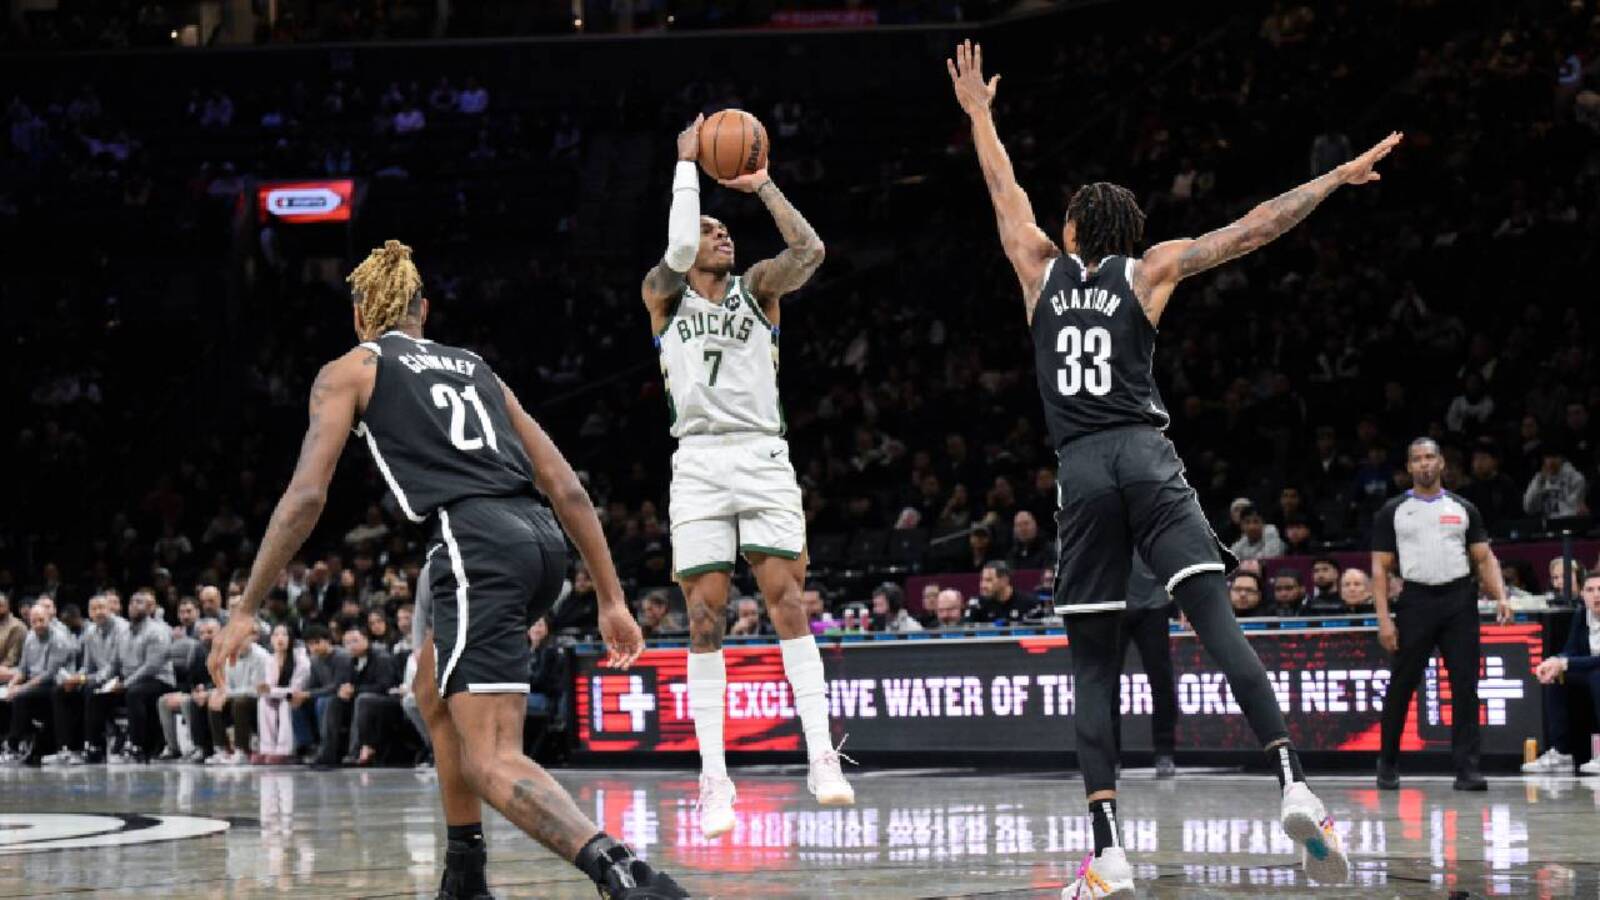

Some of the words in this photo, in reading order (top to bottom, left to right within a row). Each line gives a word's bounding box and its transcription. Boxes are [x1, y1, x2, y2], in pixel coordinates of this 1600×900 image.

[676, 312, 753, 343] BUCKS
[703, 350, 722, 387] 7
[1056, 326, 1112, 396] 33
[431, 383, 499, 453] 21
[727, 679, 877, 718] EXCLIVE
[881, 677, 984, 716] WATER
[991, 675, 1029, 715] OF
[1037, 675, 1076, 715] TH
[1300, 669, 1391, 712] NETS
